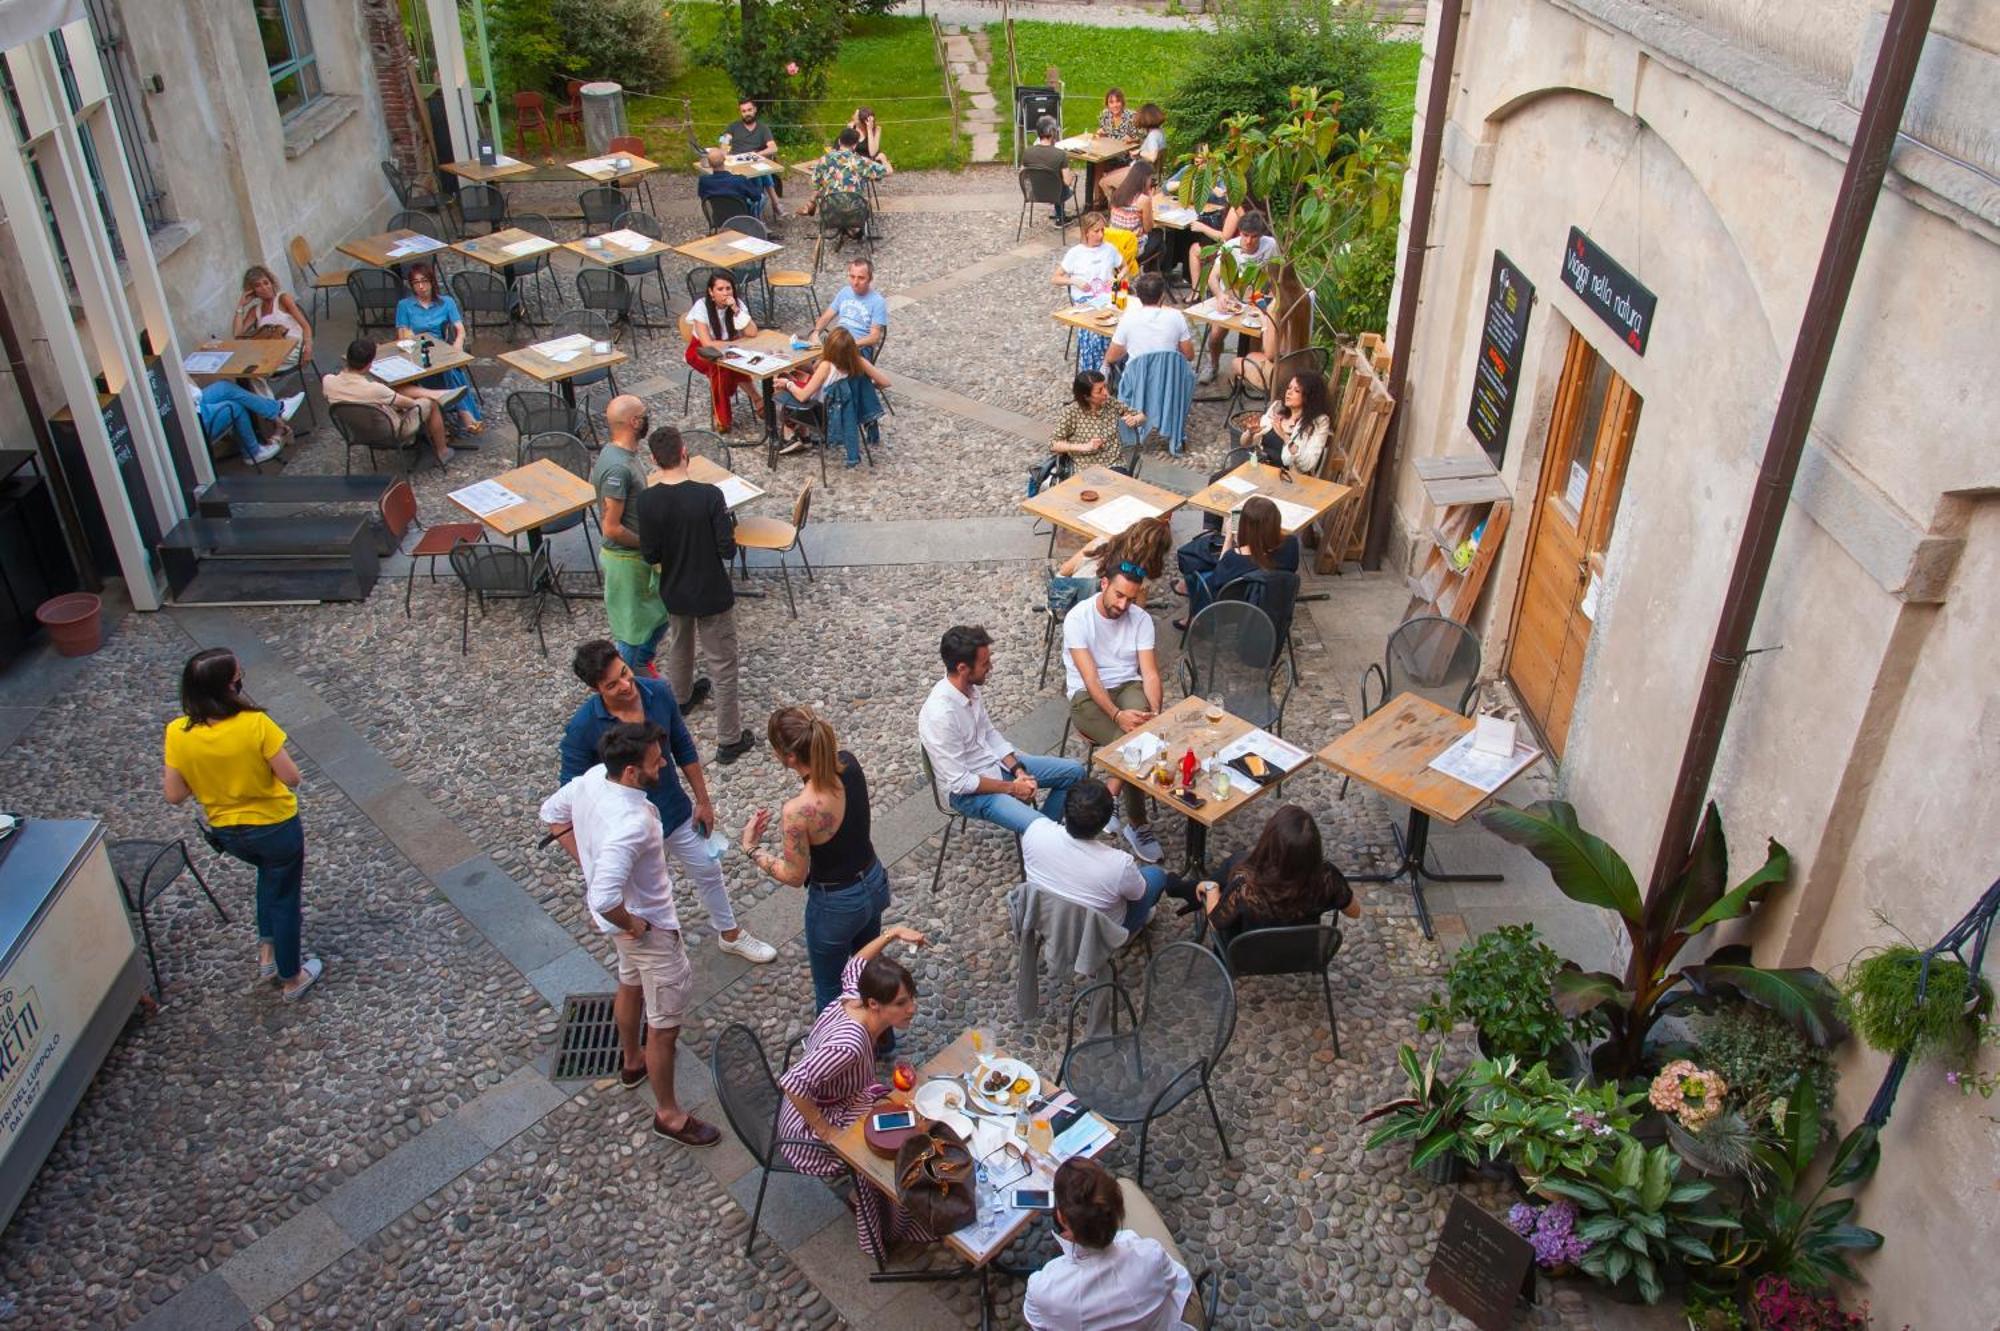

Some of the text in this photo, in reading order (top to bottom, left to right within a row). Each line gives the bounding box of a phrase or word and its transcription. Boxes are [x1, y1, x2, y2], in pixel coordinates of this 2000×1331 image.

[1567, 248, 1642, 335] Viaggi nella natura
[12, 1087, 27, 1110] DEL
[27, 1033, 60, 1086] LUPPOLO
[10, 1109, 24, 1132] DAL
